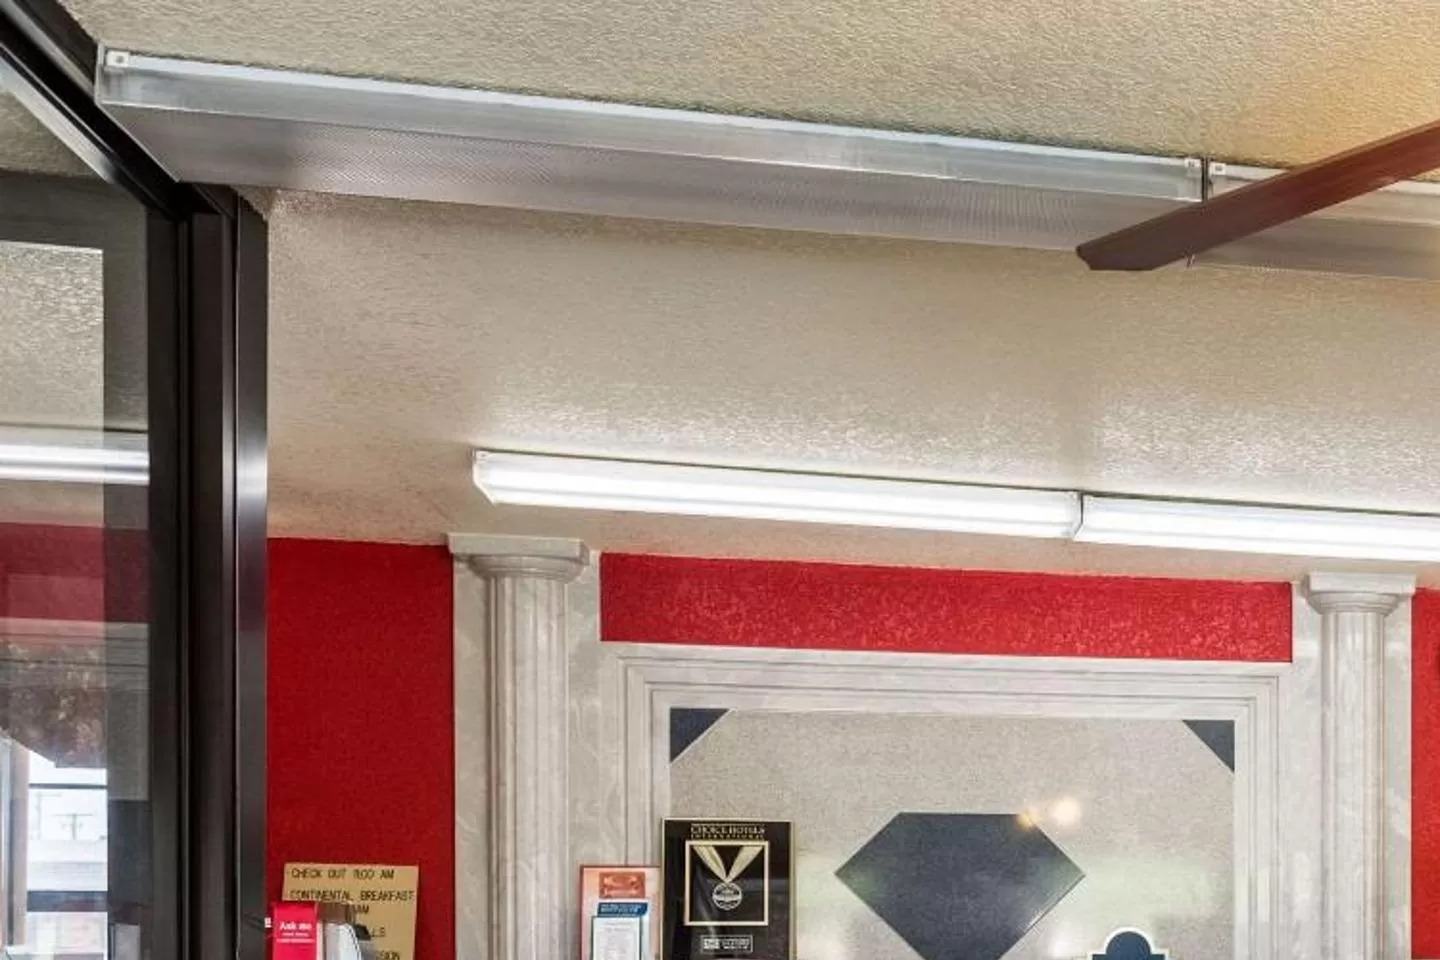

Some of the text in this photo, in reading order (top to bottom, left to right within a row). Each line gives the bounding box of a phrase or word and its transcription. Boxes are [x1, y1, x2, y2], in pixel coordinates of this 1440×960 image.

[291, 869, 322, 878] CHECK
[328, 869, 346, 879] OUT
[380, 869, 395, 879] AM
[360, 890, 415, 901] BREAKFAST
